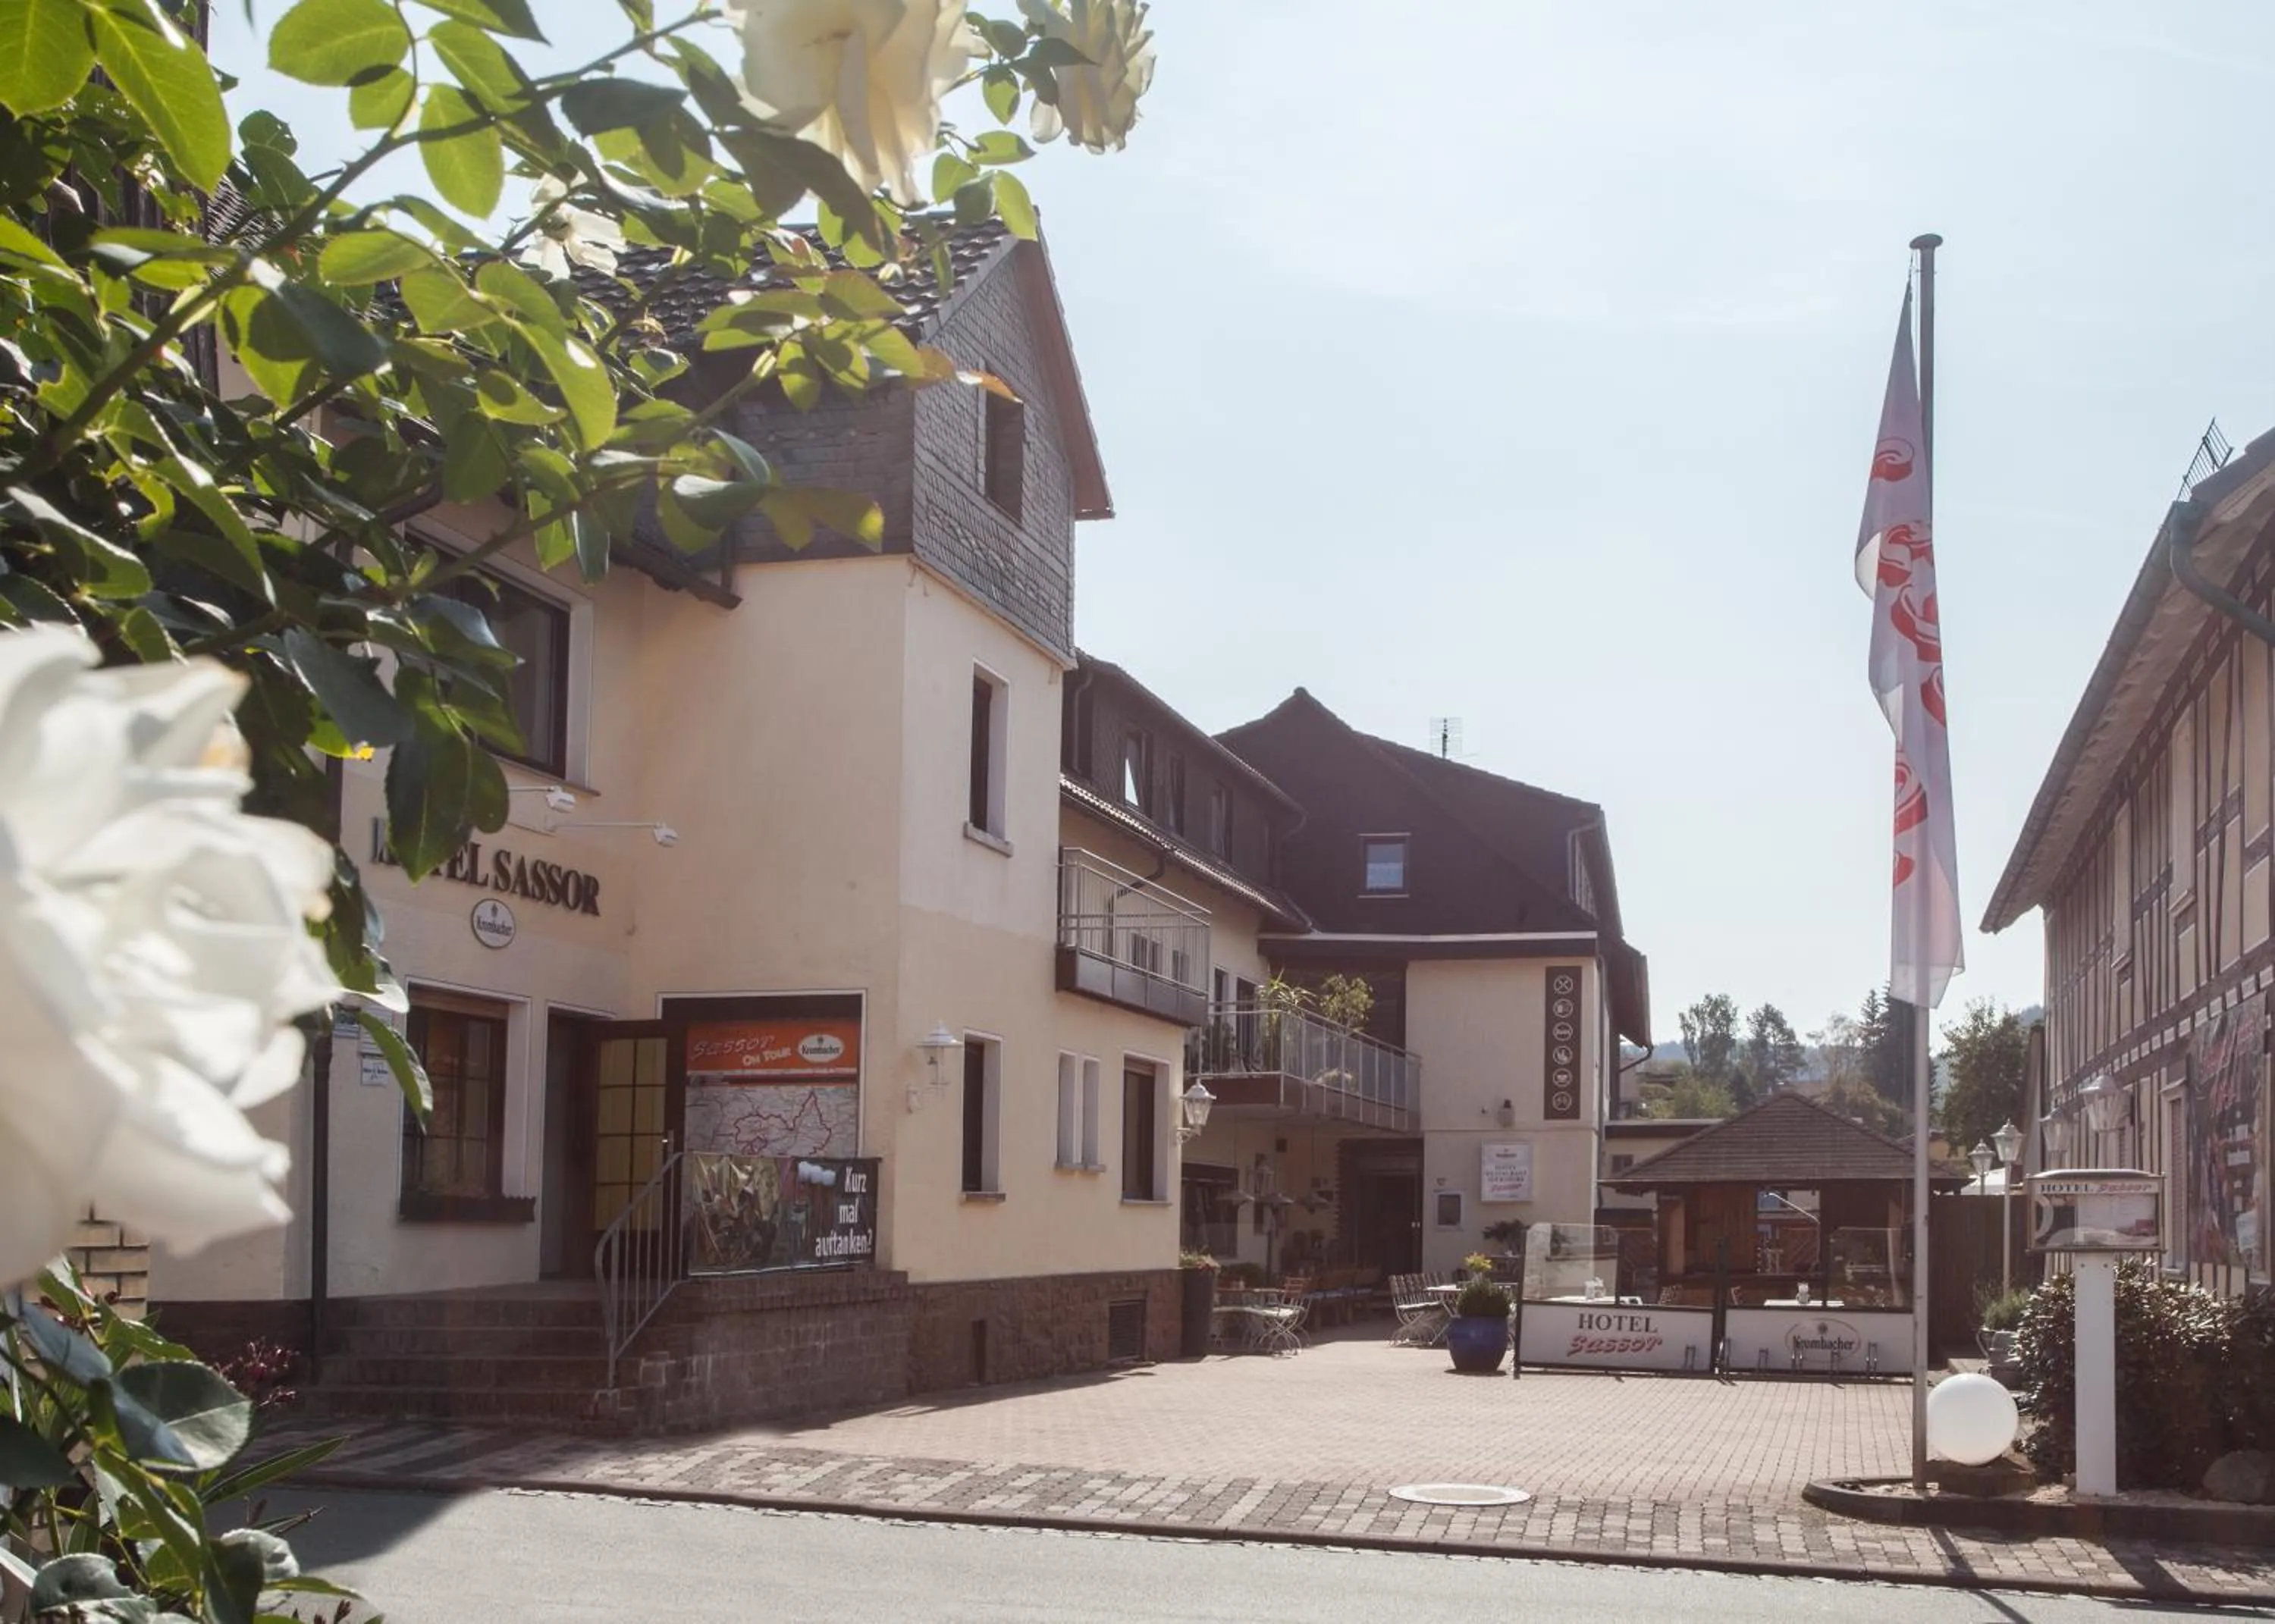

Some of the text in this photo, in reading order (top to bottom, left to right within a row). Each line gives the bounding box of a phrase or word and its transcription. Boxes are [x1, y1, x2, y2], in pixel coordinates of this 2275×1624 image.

[494, 848, 601, 917] SASSOR
[844, 1166, 867, 1193] Kurz
[2041, 1184, 2094, 1193] HOTEL
[839, 1197, 859, 1224] mal
[1578, 1313, 1658, 1333] HOTEL
[1793, 1335, 1854, 1351] Krombacher
